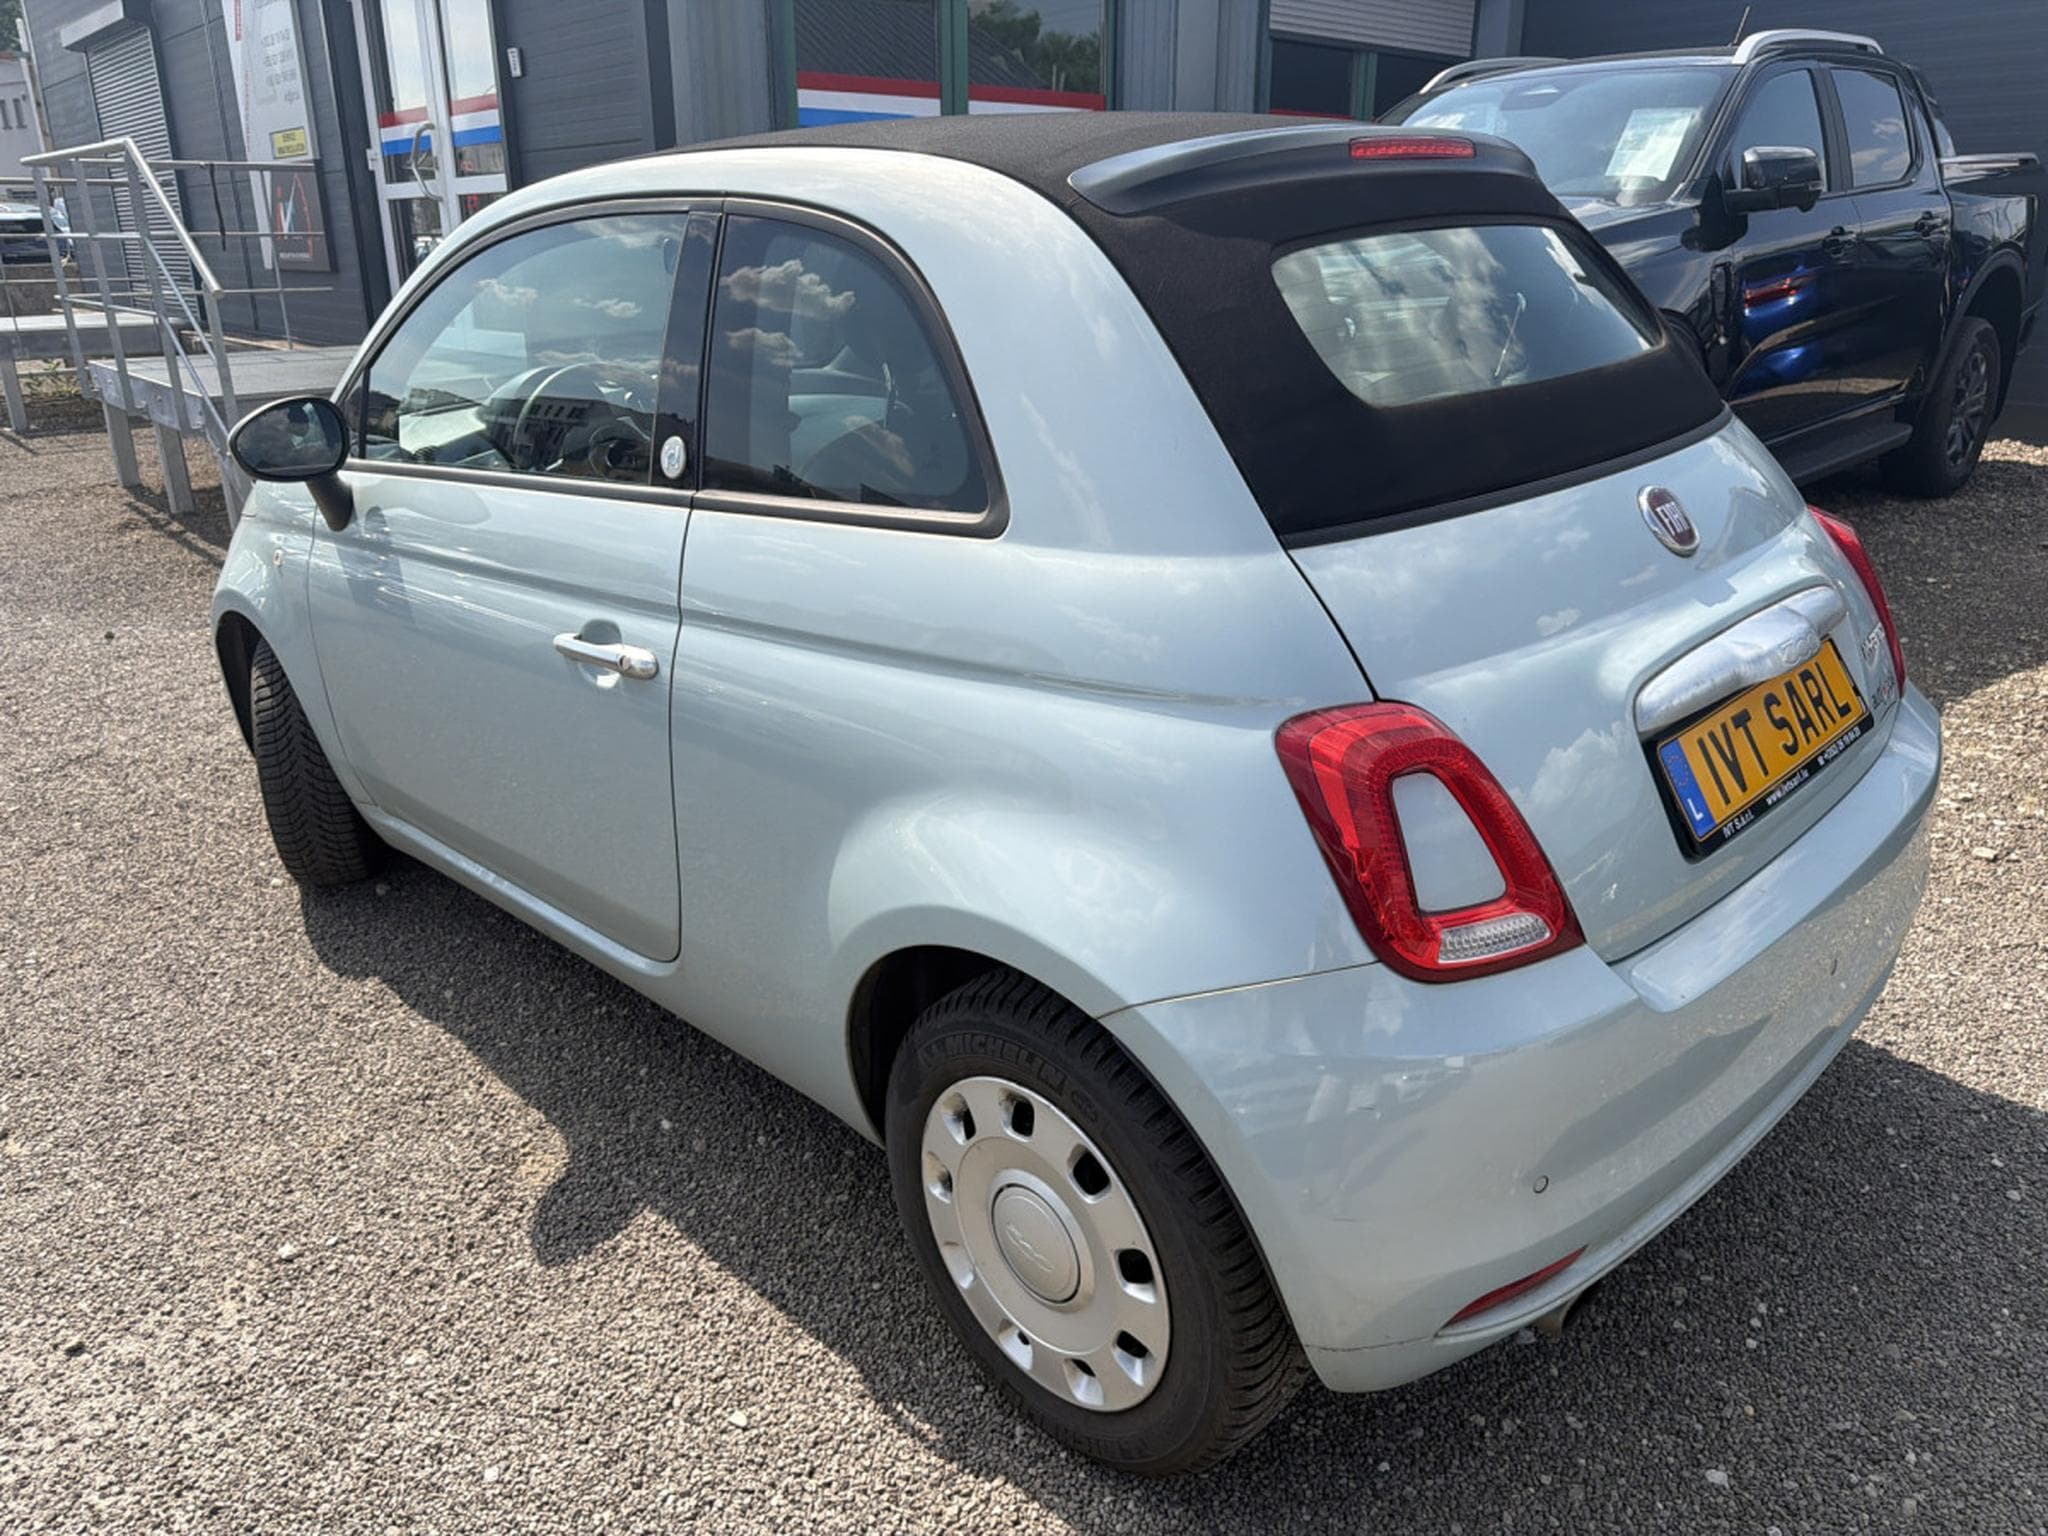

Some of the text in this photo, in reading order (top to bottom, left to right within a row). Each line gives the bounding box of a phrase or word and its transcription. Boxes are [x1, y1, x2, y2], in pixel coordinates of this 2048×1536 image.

[1697, 709, 1770, 806] IVT
[1764, 661, 1850, 756] SARL
[1687, 798, 1704, 821] L
[943, 1031, 1069, 1096] MICHELIN
